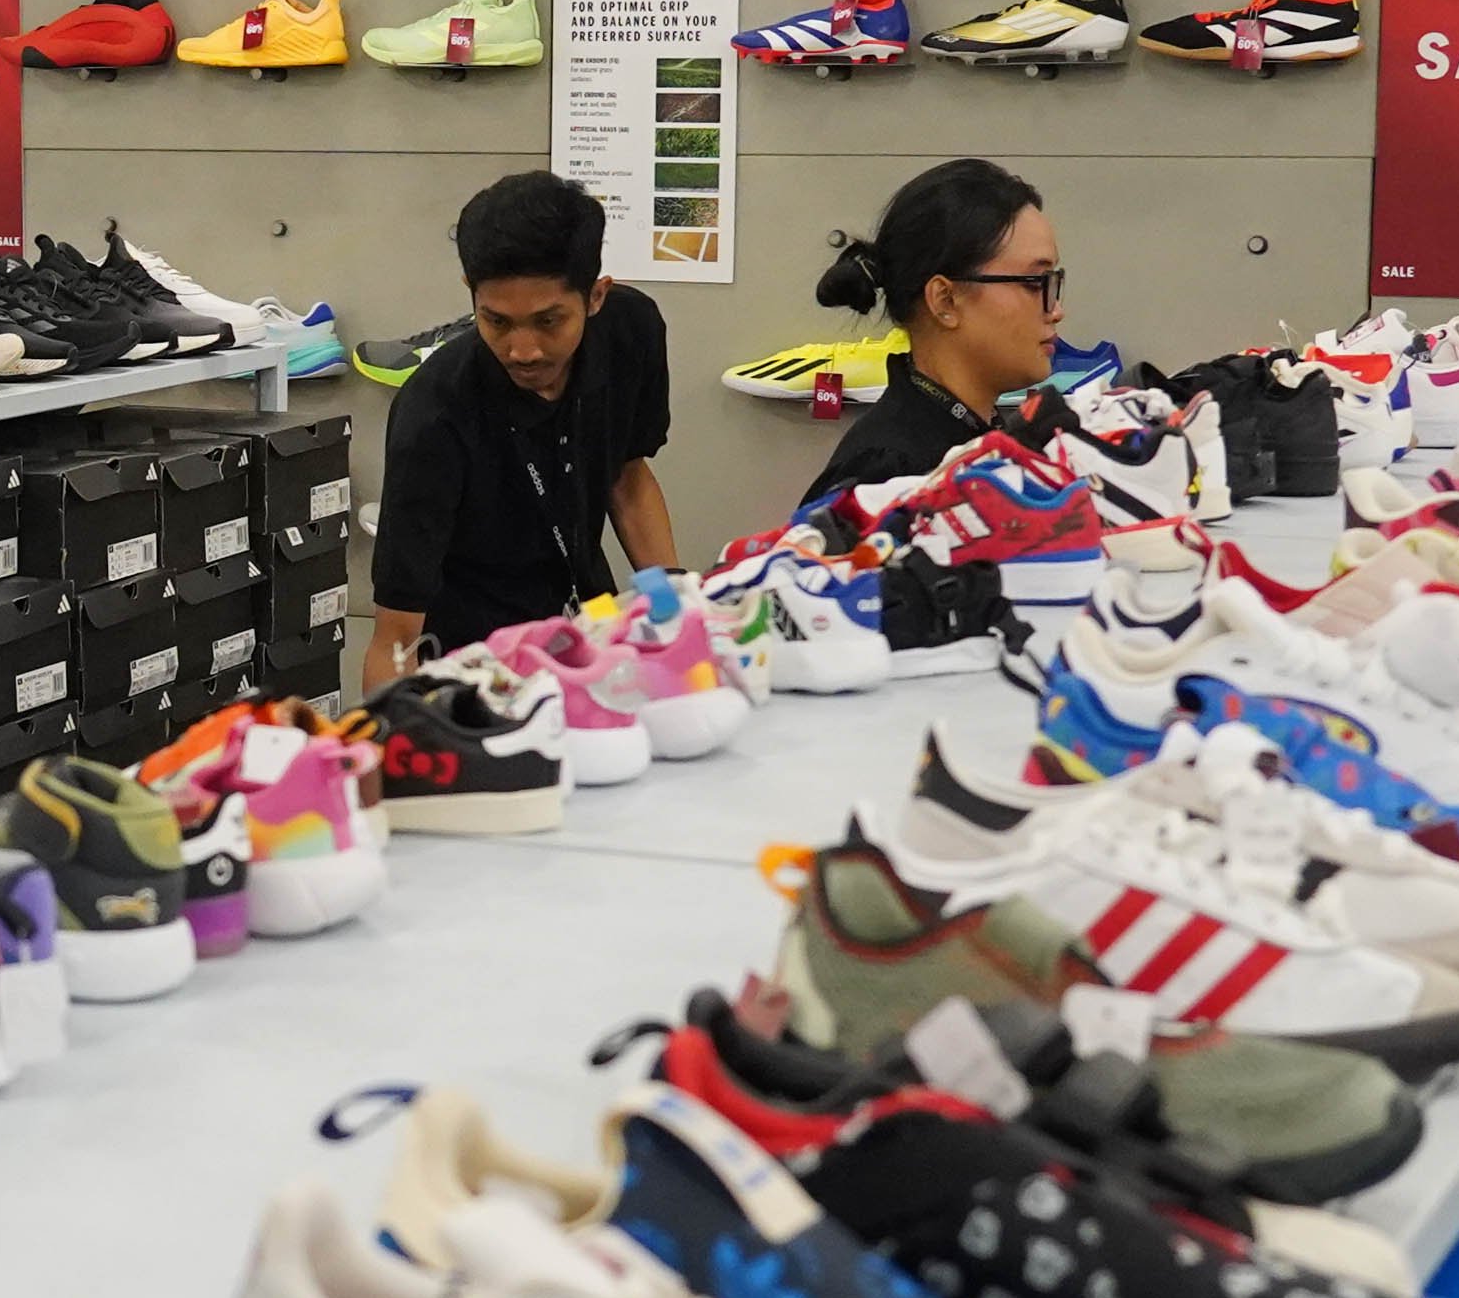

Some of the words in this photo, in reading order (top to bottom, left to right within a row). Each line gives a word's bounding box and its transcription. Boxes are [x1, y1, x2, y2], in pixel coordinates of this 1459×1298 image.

[571, 2, 594, 13] FOR
[600, 1, 653, 13] OPTIMAL
[660, 0, 690, 12] GRIP
[571, 16, 595, 27] AND
[601, 15, 656, 27] BALANCE
[663, 15, 678, 27] ON
[685, 14, 718, 27] YOUR
[451, 35, 471, 47] 60%
[571, 30, 640, 42] PREFERRED
[647, 30, 702, 42] SURFACE
[1237, 39, 1260, 53] 60%
[1381, 265, 1415, 278] SALE
[817, 392, 838, 404] 60%
